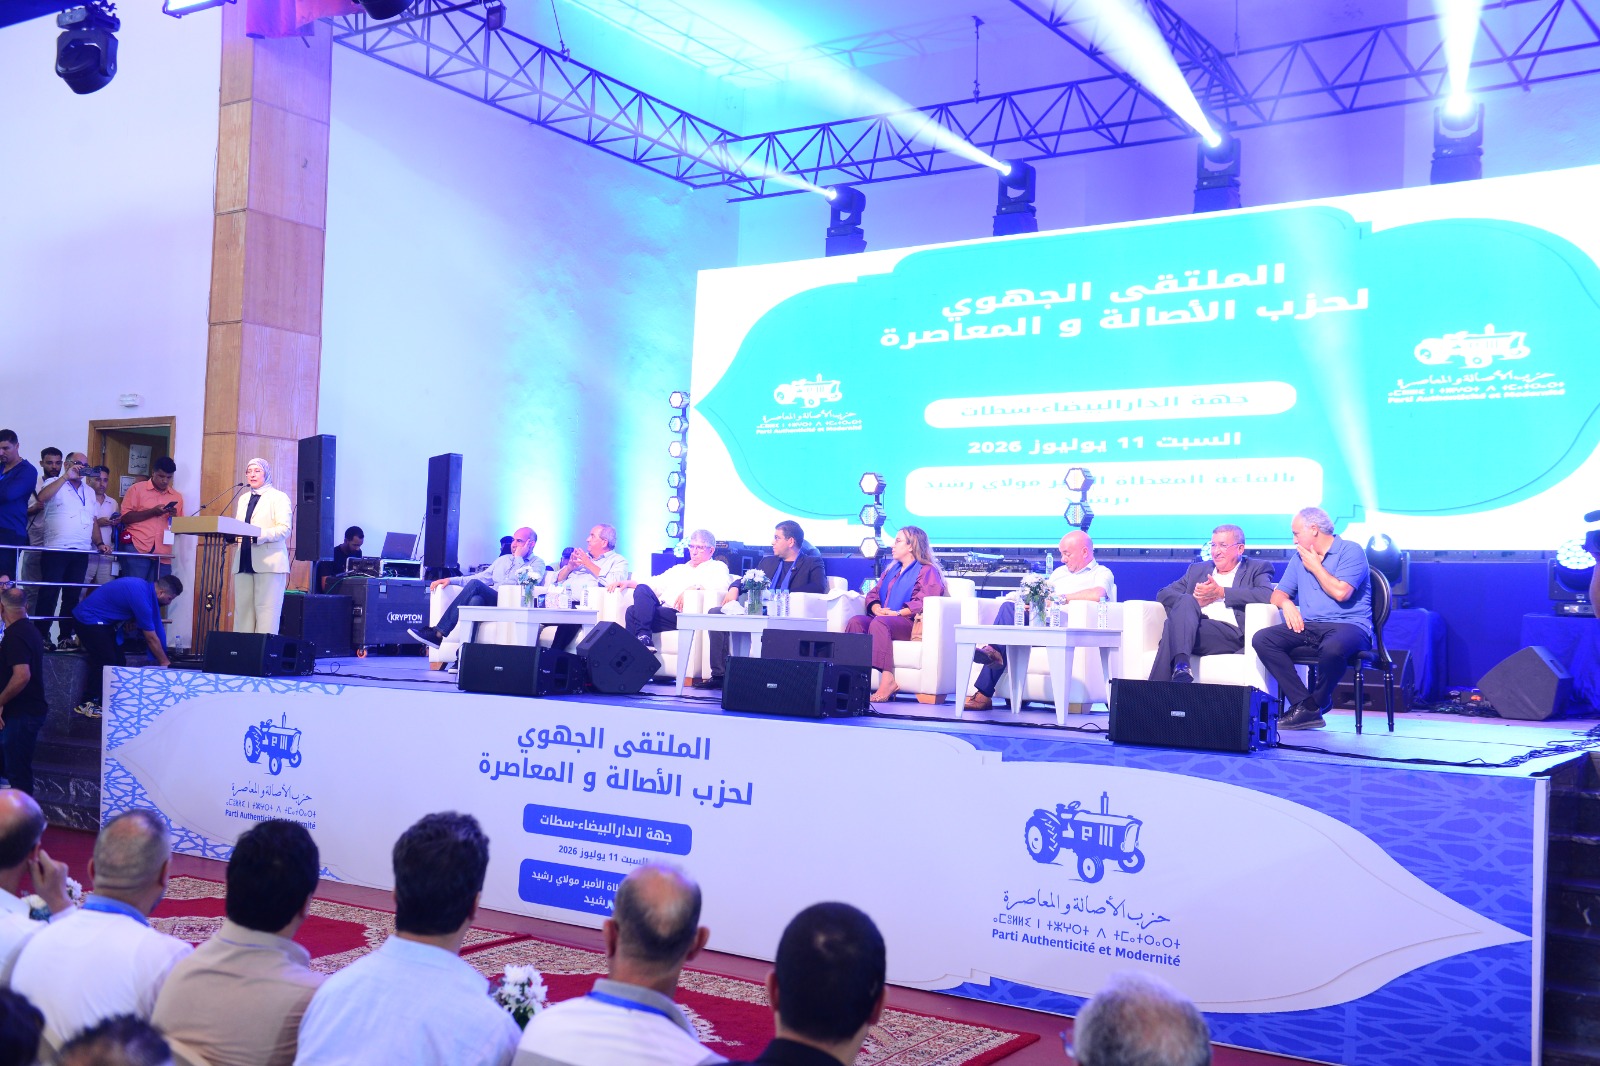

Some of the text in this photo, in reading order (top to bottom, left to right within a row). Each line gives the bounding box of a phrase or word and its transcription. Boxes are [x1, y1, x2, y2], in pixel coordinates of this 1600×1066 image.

[942, 262, 1285, 322] الملتقى الجهوي
[880, 288, 1369, 350] لحزب الأصالة و المعاصرة
[1191, 393, 1249, 407] جهة
[1388, 395, 1414, 404] Parti
[968, 431, 1241, 455] السبت 11 يوليوز 2026
[390, 613, 423, 621] KRYPTON
[517, 724, 711, 761] الملتقى الجهوي
[479, 751, 754, 809] لحزب الأصالة و المعاصرة
[291, 793, 313, 806] حزب
[225, 808, 239, 818] Parti
[540, 814, 672, 846] جهة الدارالبيضاء-سطات
[558, 845, 578, 855] 2026
[579, 847, 606, 862] يوليوز
[608, 852, 619, 862] 11
[531, 870, 553, 883] رشيد
[555, 874, 580, 887] مولاي
[581, 877, 605, 890] الأمير
[583, 894, 611, 910] رشيد
[1073, 895, 1127, 918] الأصالة
[1127, 911, 1171, 930] حزب
[992, 928, 1181, 967] Parti Authenticité et Modernité
